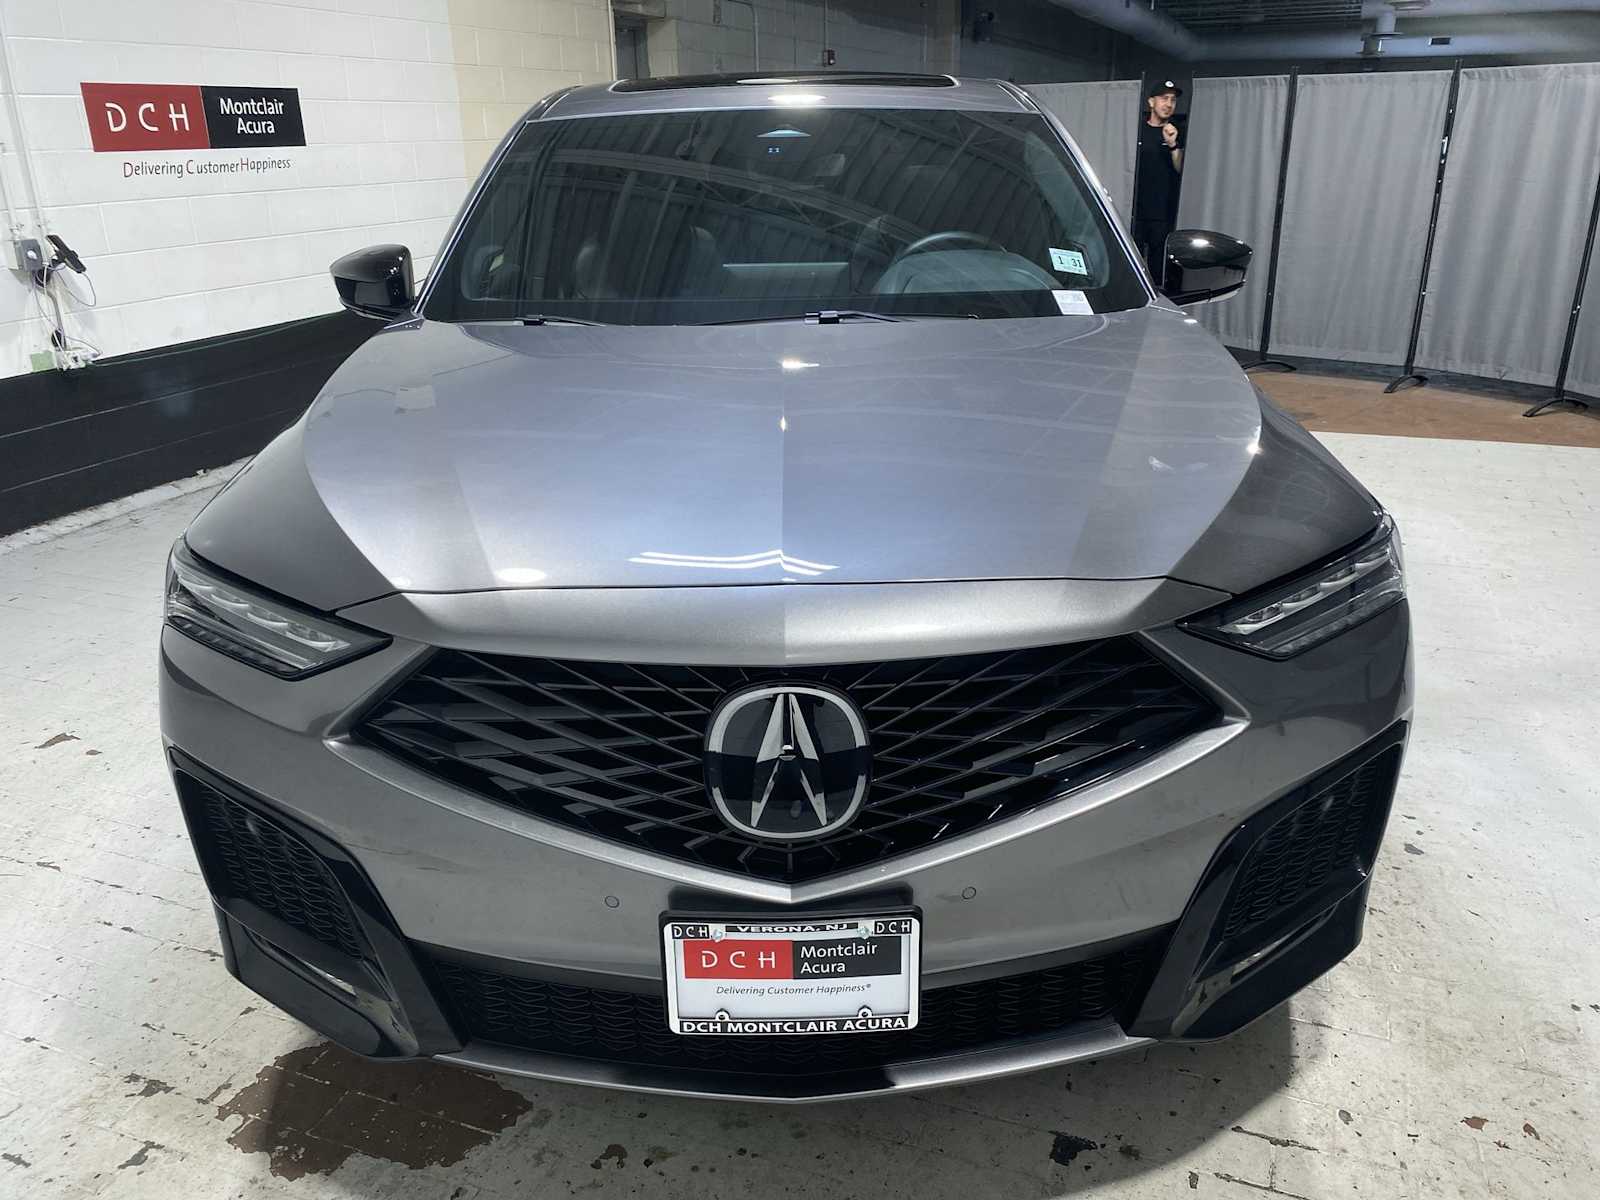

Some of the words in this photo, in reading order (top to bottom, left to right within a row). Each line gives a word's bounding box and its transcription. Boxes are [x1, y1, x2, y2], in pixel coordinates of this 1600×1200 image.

[219, 97, 284, 116] Montclair
[104, 102, 190, 132] DCH
[236, 117, 275, 135] Acura
[123, 161, 184, 178] Delivering
[1071, 258, 1083, 268] 31
[672, 925, 709, 938] DCH
[825, 923, 848, 931] NJ
[876, 920, 911, 934] DCH
[800, 941, 878, 959] Montclair
[701, 950, 776, 969] DCH
[800, 961, 846, 974] Acura
[716, 985, 765, 997] Delivering
[767, 986, 814, 995] Customer
[682, 1021, 721, 1033] DCH
[727, 1020, 837, 1033] MONTCLAIR
[843, 1017, 906, 1031] ACURA
